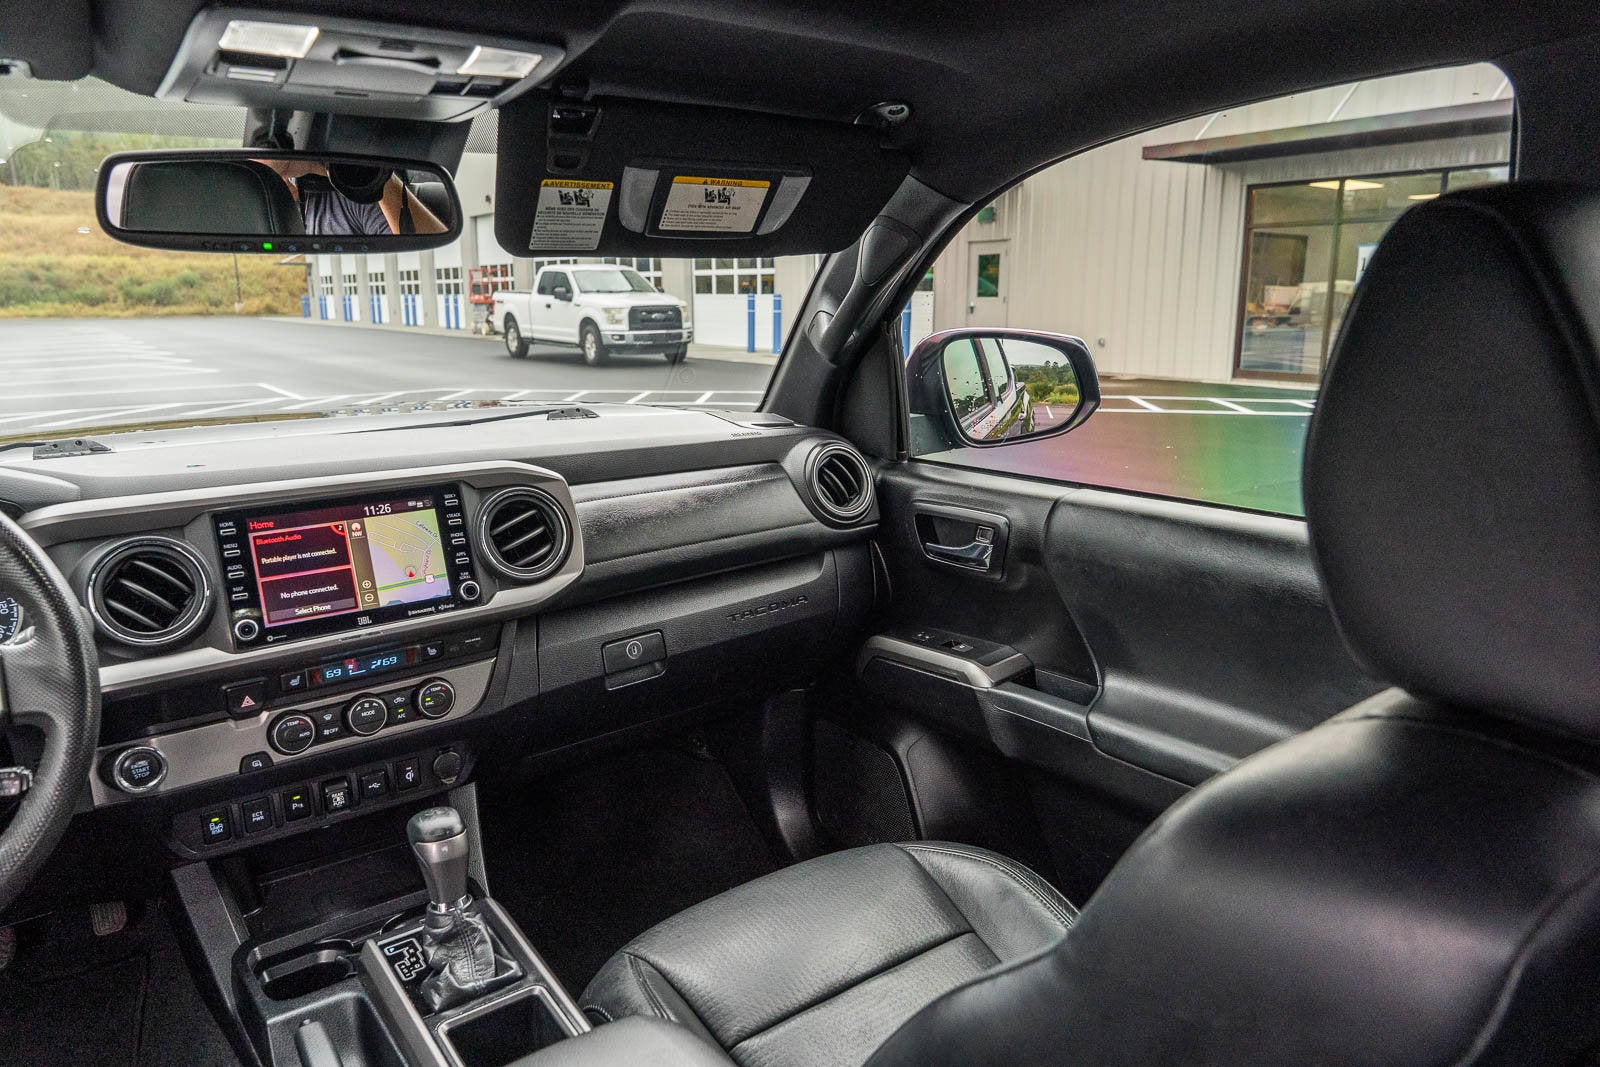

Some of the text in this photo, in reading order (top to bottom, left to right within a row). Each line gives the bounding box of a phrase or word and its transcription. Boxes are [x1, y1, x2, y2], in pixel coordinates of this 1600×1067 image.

[551, 181, 611, 189] AVERTISSEMENT
[363, 503, 392, 516] 11:26
[249, 521, 275, 530] Home
[255, 535, 285, 545] Bluetooth
[261, 555, 283, 565] Portable
[282, 554, 297, 563] player
[311, 548, 337, 558] connected.
[291, 589, 308, 598] phone
[309, 584, 339, 595] connected.
[295, 604, 331, 616] Select Phone
[725, 595, 809, 622] TACOMA
[382, 656, 397, 666] 69
[326, 668, 342, 679] 69
[361, 709, 376, 717] MODE
[131, 766, 150, 775] START
[134, 771, 150, 780] STOP
[251, 810, 263, 818] ECT
